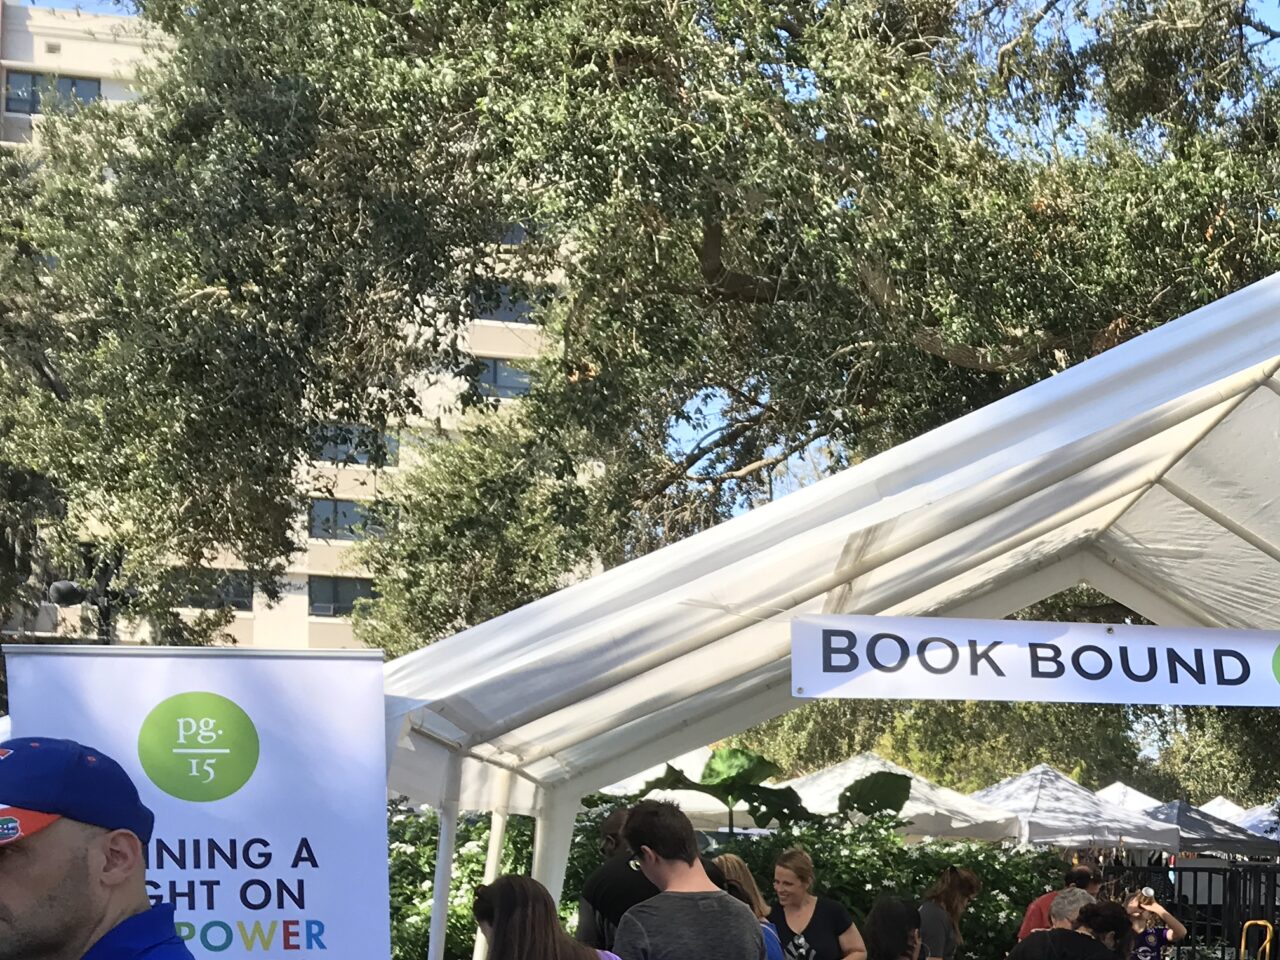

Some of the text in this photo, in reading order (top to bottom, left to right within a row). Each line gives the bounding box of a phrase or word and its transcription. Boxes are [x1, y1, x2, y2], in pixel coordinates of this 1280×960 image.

[822, 628, 1251, 686] BOOK BOUND
[176, 717, 224, 745] pg.
[187, 758, 217, 784] 15
[145, 836, 319, 870] INING A
[145, 878, 305, 911] GHT ON
[175, 919, 327, 952] POWER
